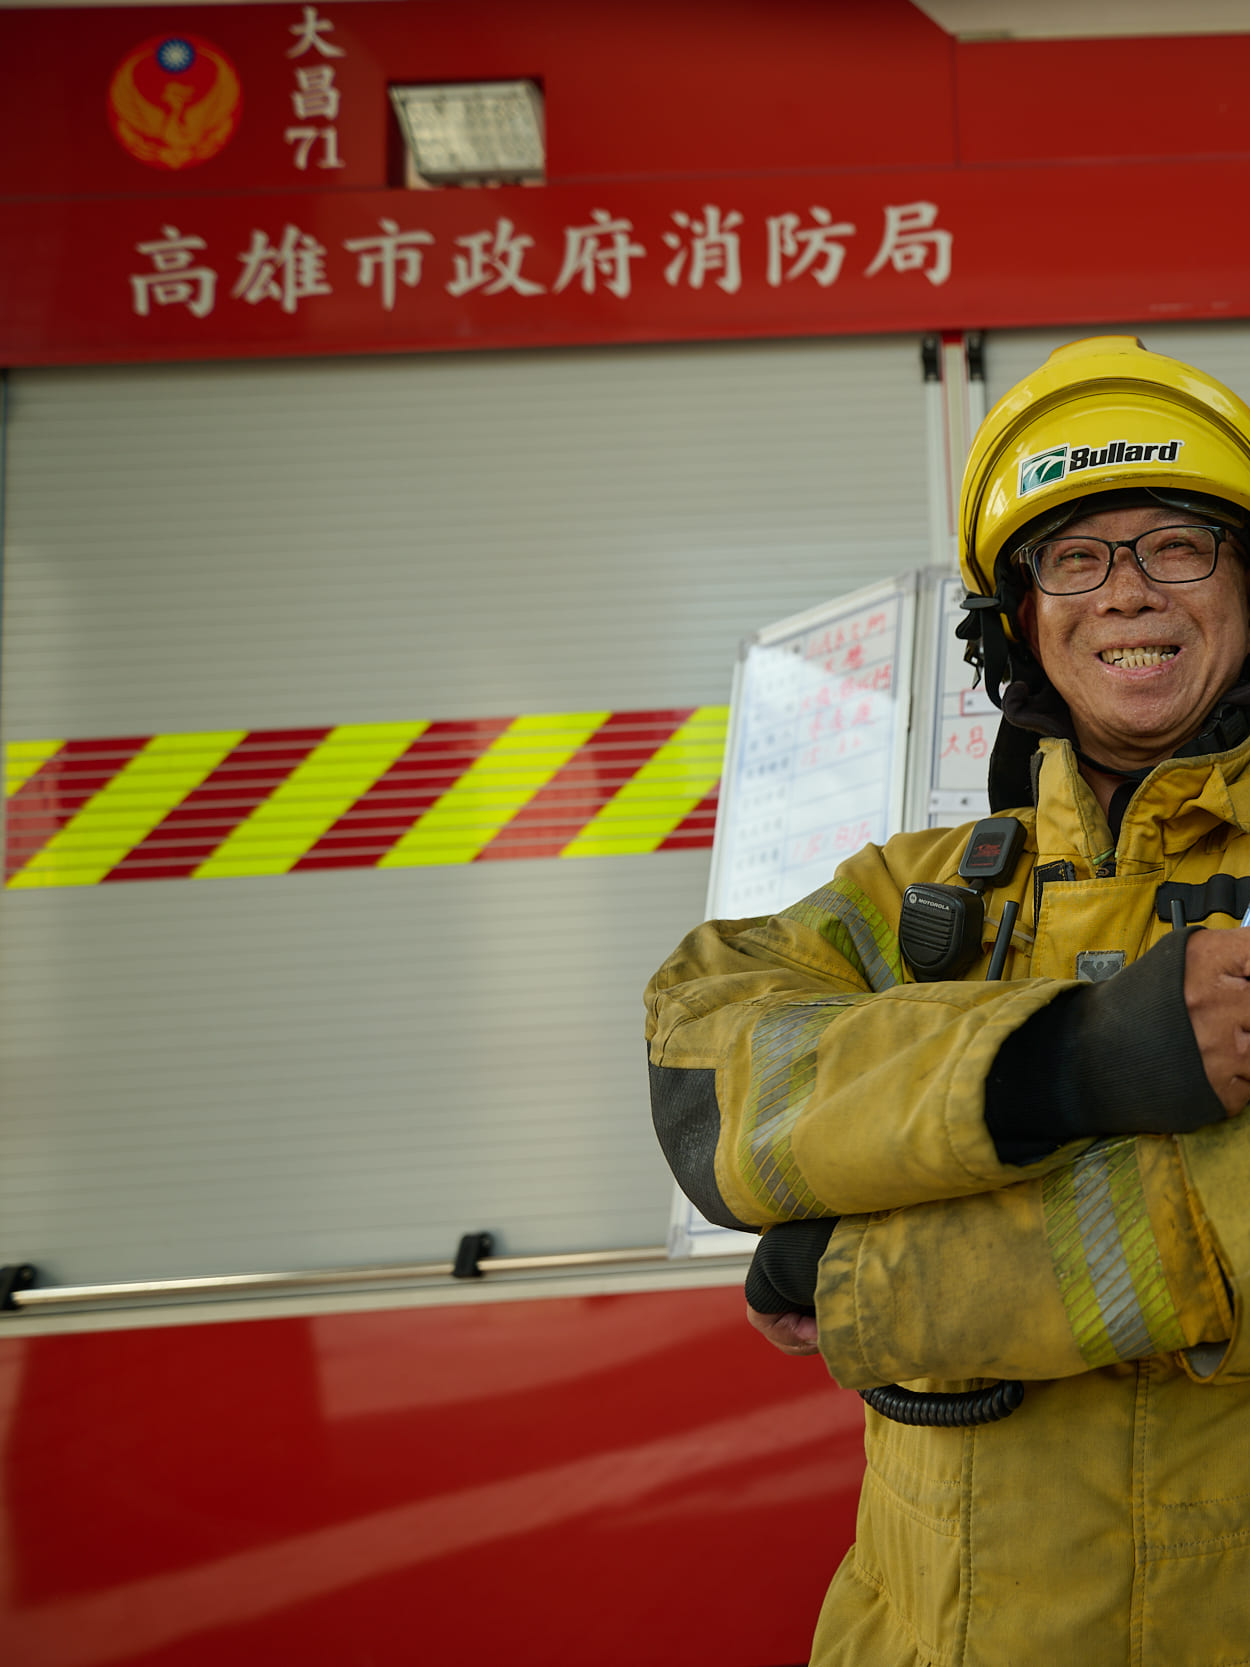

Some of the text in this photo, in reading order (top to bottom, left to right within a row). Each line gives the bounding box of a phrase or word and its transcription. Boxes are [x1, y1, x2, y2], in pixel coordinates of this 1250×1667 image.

[128, 201, 954, 318] 高雄市政府消防局
[1069, 441, 1179, 472] Bullard
[918, 898, 950, 911] MOTOROLA
